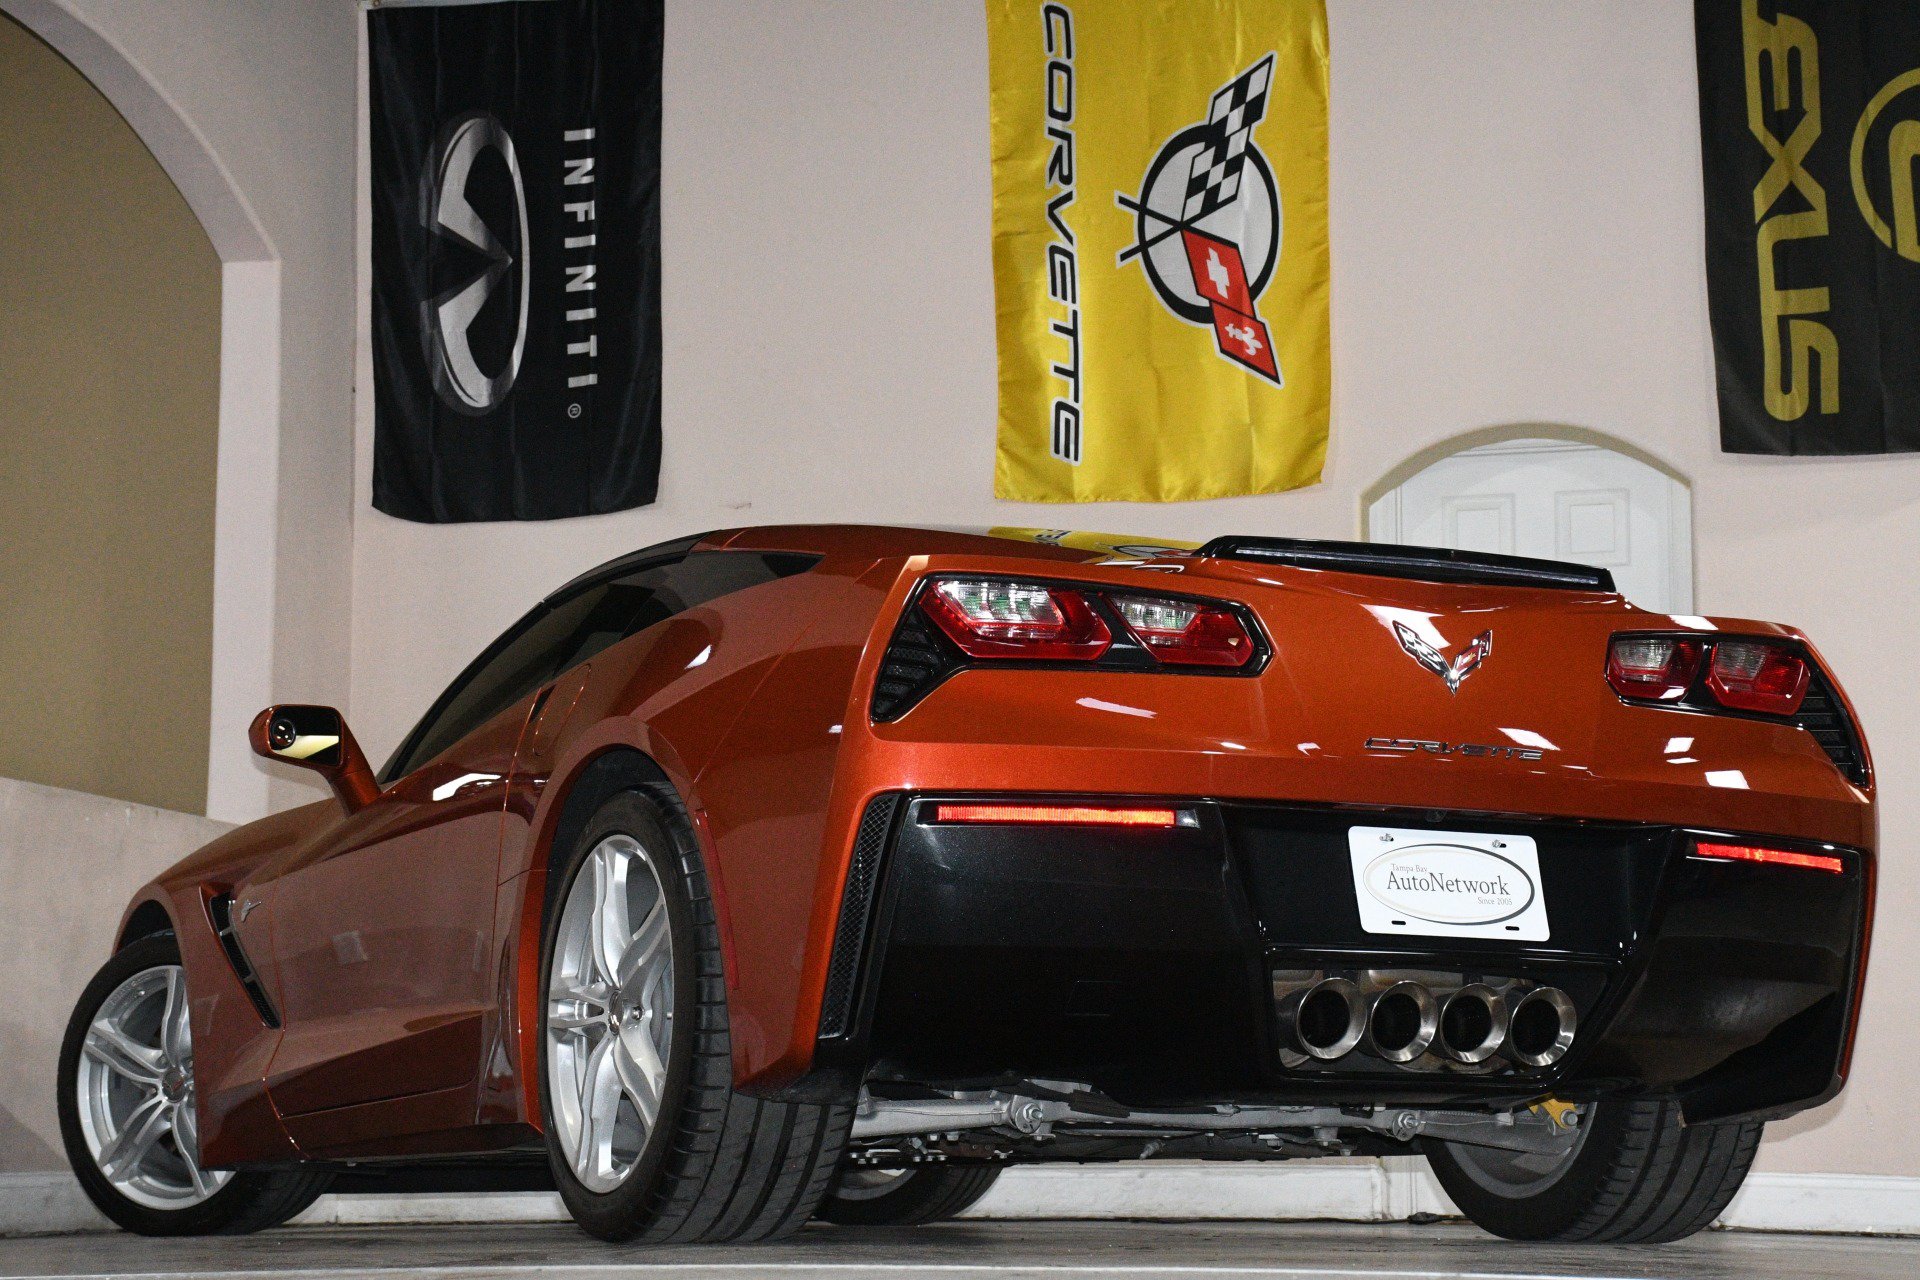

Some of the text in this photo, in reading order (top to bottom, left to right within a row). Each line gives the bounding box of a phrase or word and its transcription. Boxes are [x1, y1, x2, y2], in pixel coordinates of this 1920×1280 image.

[1741, 0, 1840, 422] EXUS
[1043, 2, 1081, 465] CORVETTE
[564, 127, 597, 389] INFINITI
[1364, 737, 1543, 760] CORVETTE
[1391, 863, 1428, 874] Tampa Bay
[1387, 871, 1511, 896] AutoNetwork
[1477, 896, 1513, 906] Since 2005
